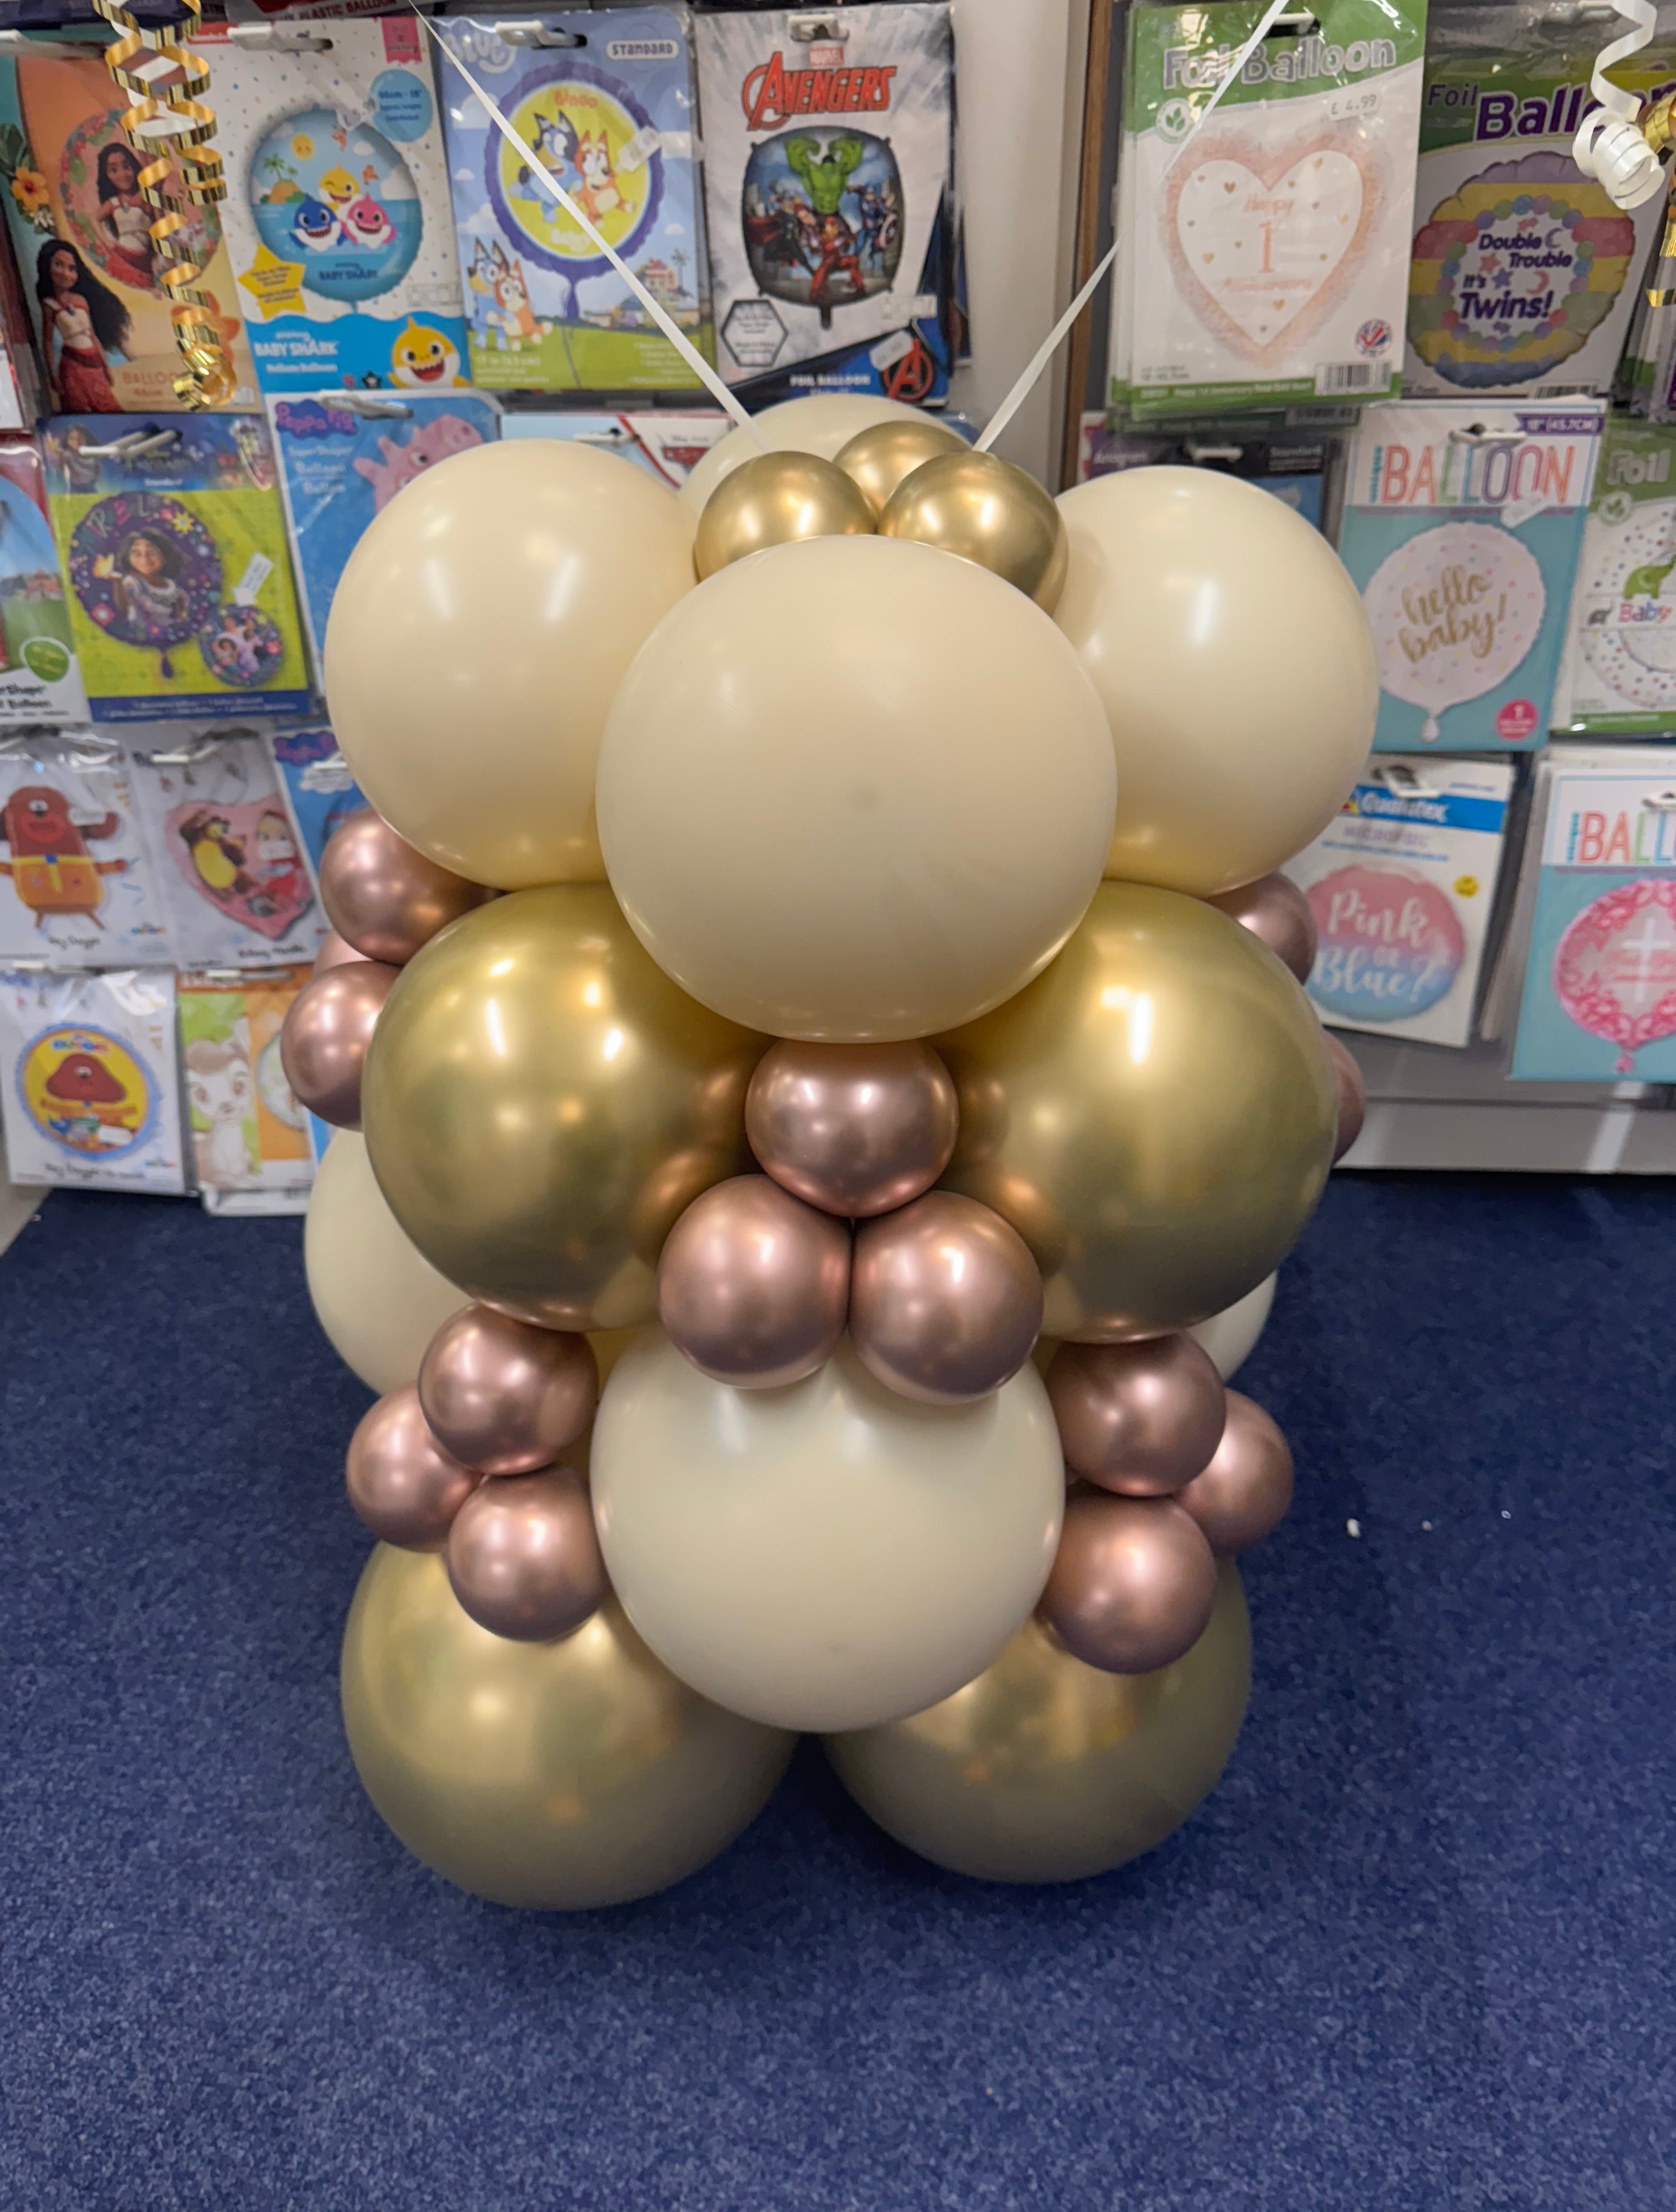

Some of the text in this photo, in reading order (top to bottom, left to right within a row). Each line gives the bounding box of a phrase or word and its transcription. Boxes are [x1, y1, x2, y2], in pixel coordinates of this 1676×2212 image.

[1241, 36, 1397, 85] Balloon
[742, 51, 897, 131] AVENGERS
[1345, 94, 1377, 111] 4.99
[1428, 83, 1479, 107] Foil
[1259, 221, 1274, 274] 1
[1478, 233, 1542, 250] Double
[1509, 251, 1572, 268] Trouble
[1463, 274, 1486, 288] It's
[1460, 290, 1554, 319] Twins!
[254, 339, 339, 357] BABY SHARK
[1380, 444, 1576, 505] BALLOON
[1608, 448, 1672, 485] Foil
[1400, 562, 1493, 626] hello
[1618, 602, 1672, 624] Baby
[1578, 810, 1676, 865] BALL
[1327, 888, 1430, 949] Pink
